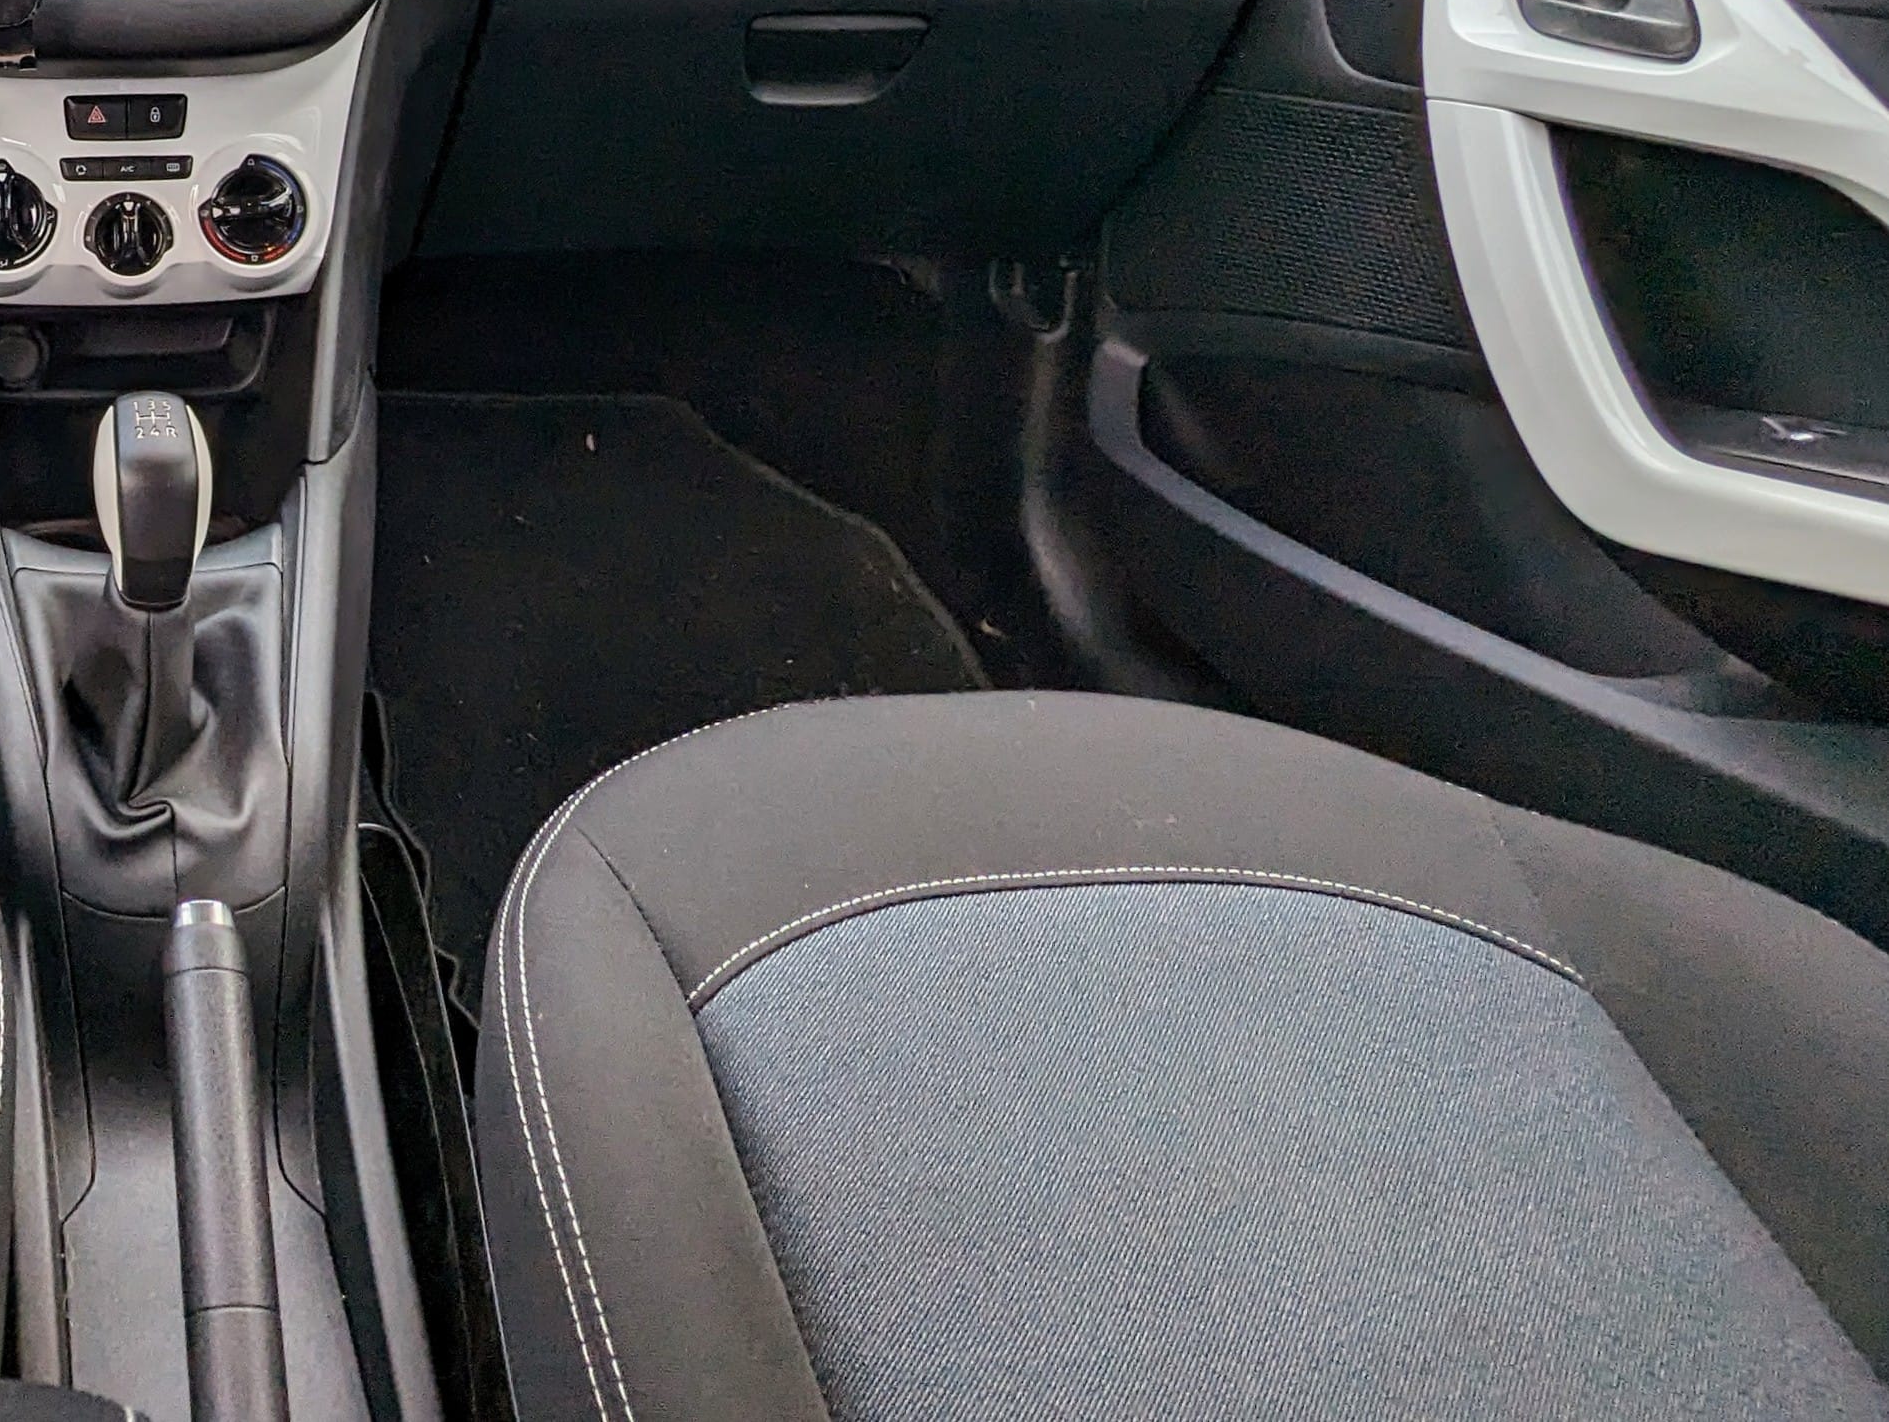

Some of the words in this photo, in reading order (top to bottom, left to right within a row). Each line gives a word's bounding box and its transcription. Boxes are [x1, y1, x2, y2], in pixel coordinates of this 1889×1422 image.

[147, 399, 156, 411] 3
[162, 400, 172, 411] 5
[135, 426, 144, 439] 2
[150, 426, 161, 437] 4
[165, 426, 178, 438] R
